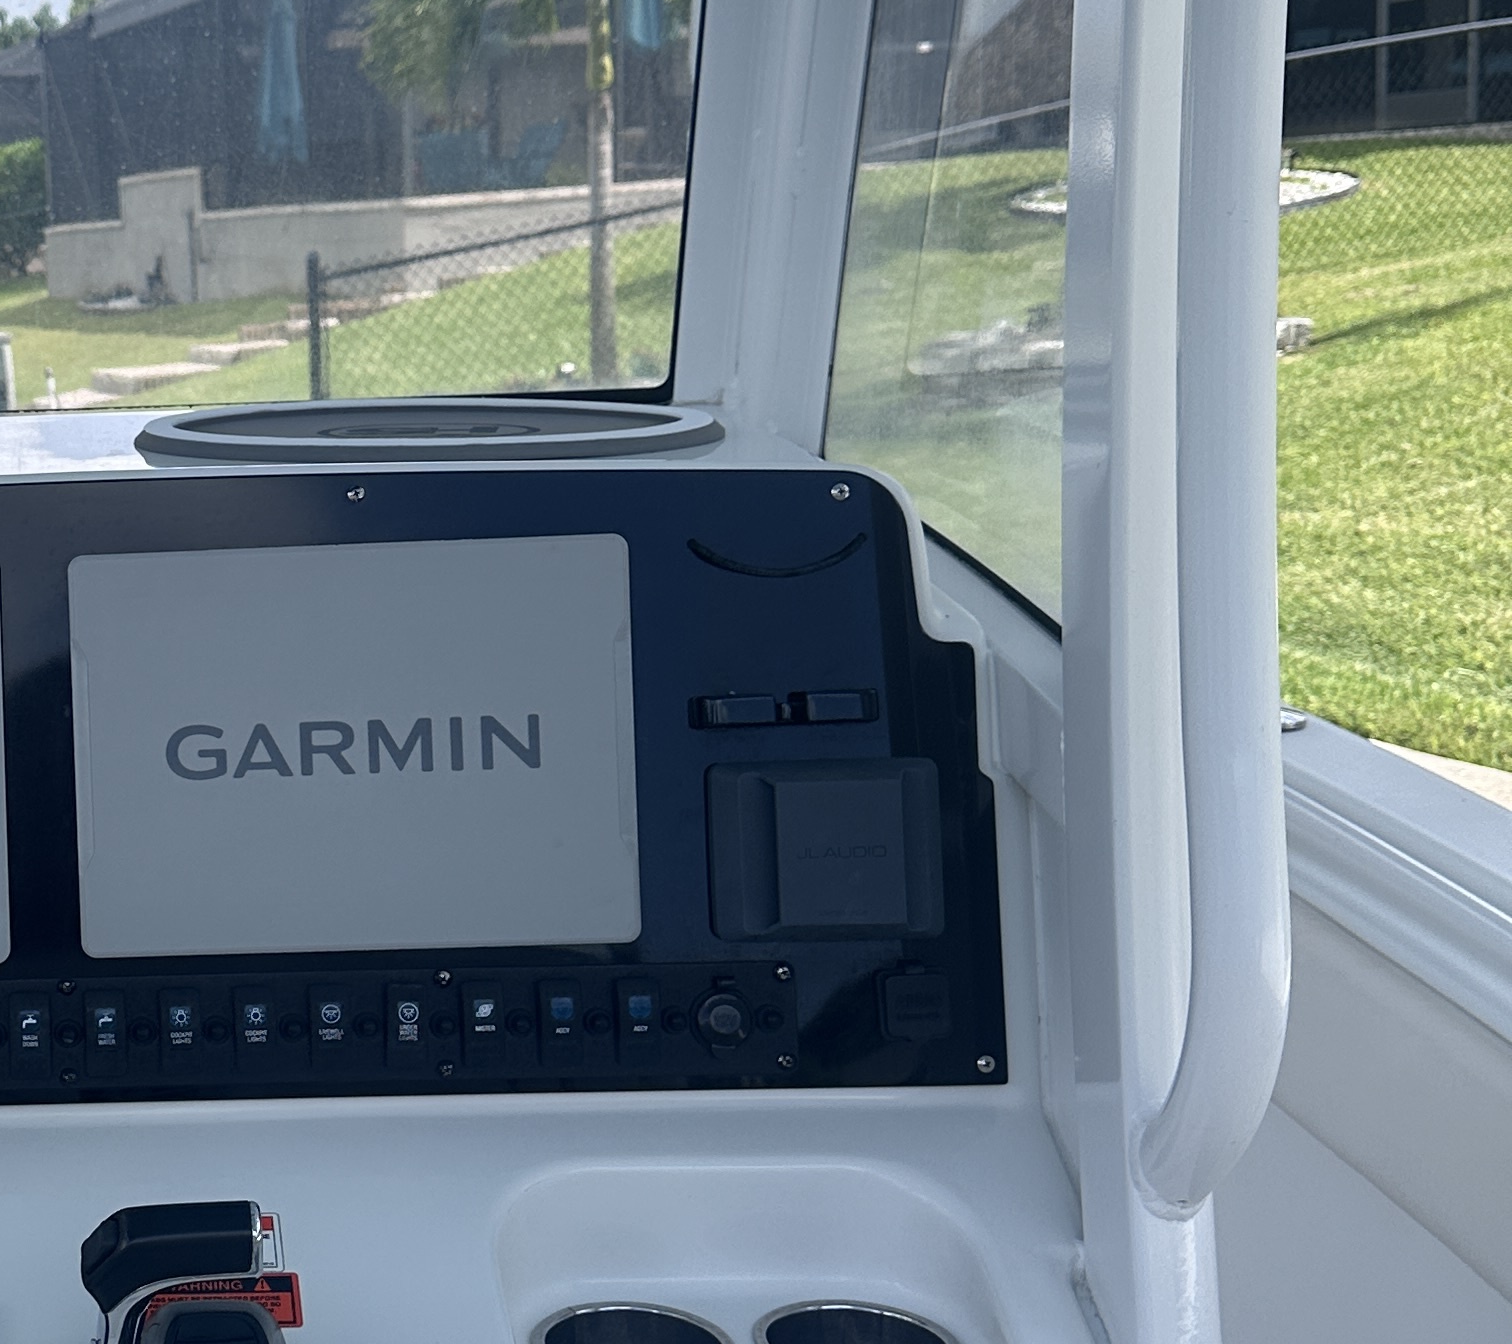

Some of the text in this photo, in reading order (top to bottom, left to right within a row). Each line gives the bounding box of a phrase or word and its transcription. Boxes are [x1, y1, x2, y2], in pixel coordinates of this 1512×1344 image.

[165, 713, 541, 780] GARMIN
[797, 845, 887, 860] JL AUDIO
